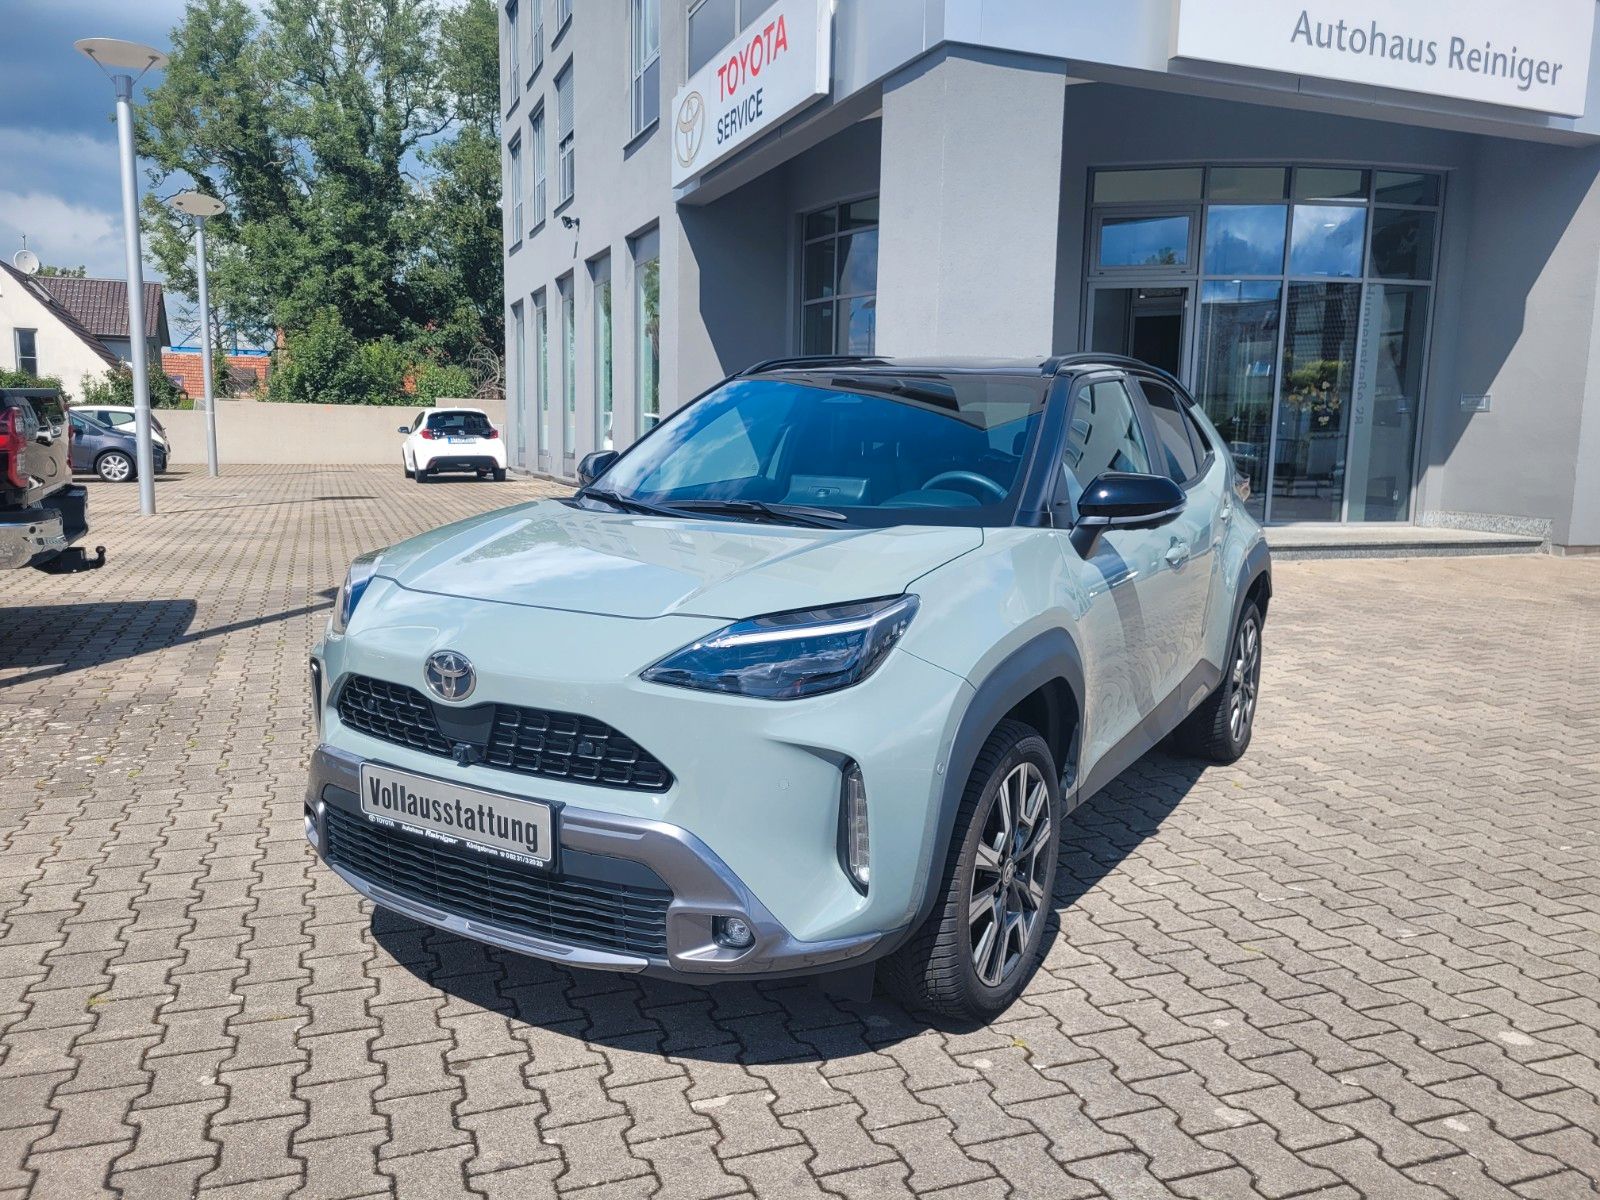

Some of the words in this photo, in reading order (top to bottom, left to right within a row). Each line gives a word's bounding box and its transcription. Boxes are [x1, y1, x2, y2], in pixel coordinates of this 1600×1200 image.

[716, 13, 788, 103] TOYOTA
[1290, 9, 1438, 66] Autohaus
[1448, 35, 1563, 92] Reiniger
[716, 87, 764, 145] SERVICE
[369, 776, 538, 853] Vollausstattung
[376, 816, 395, 827] TOYOTA
[425, 829, 459, 844] Reiniger
